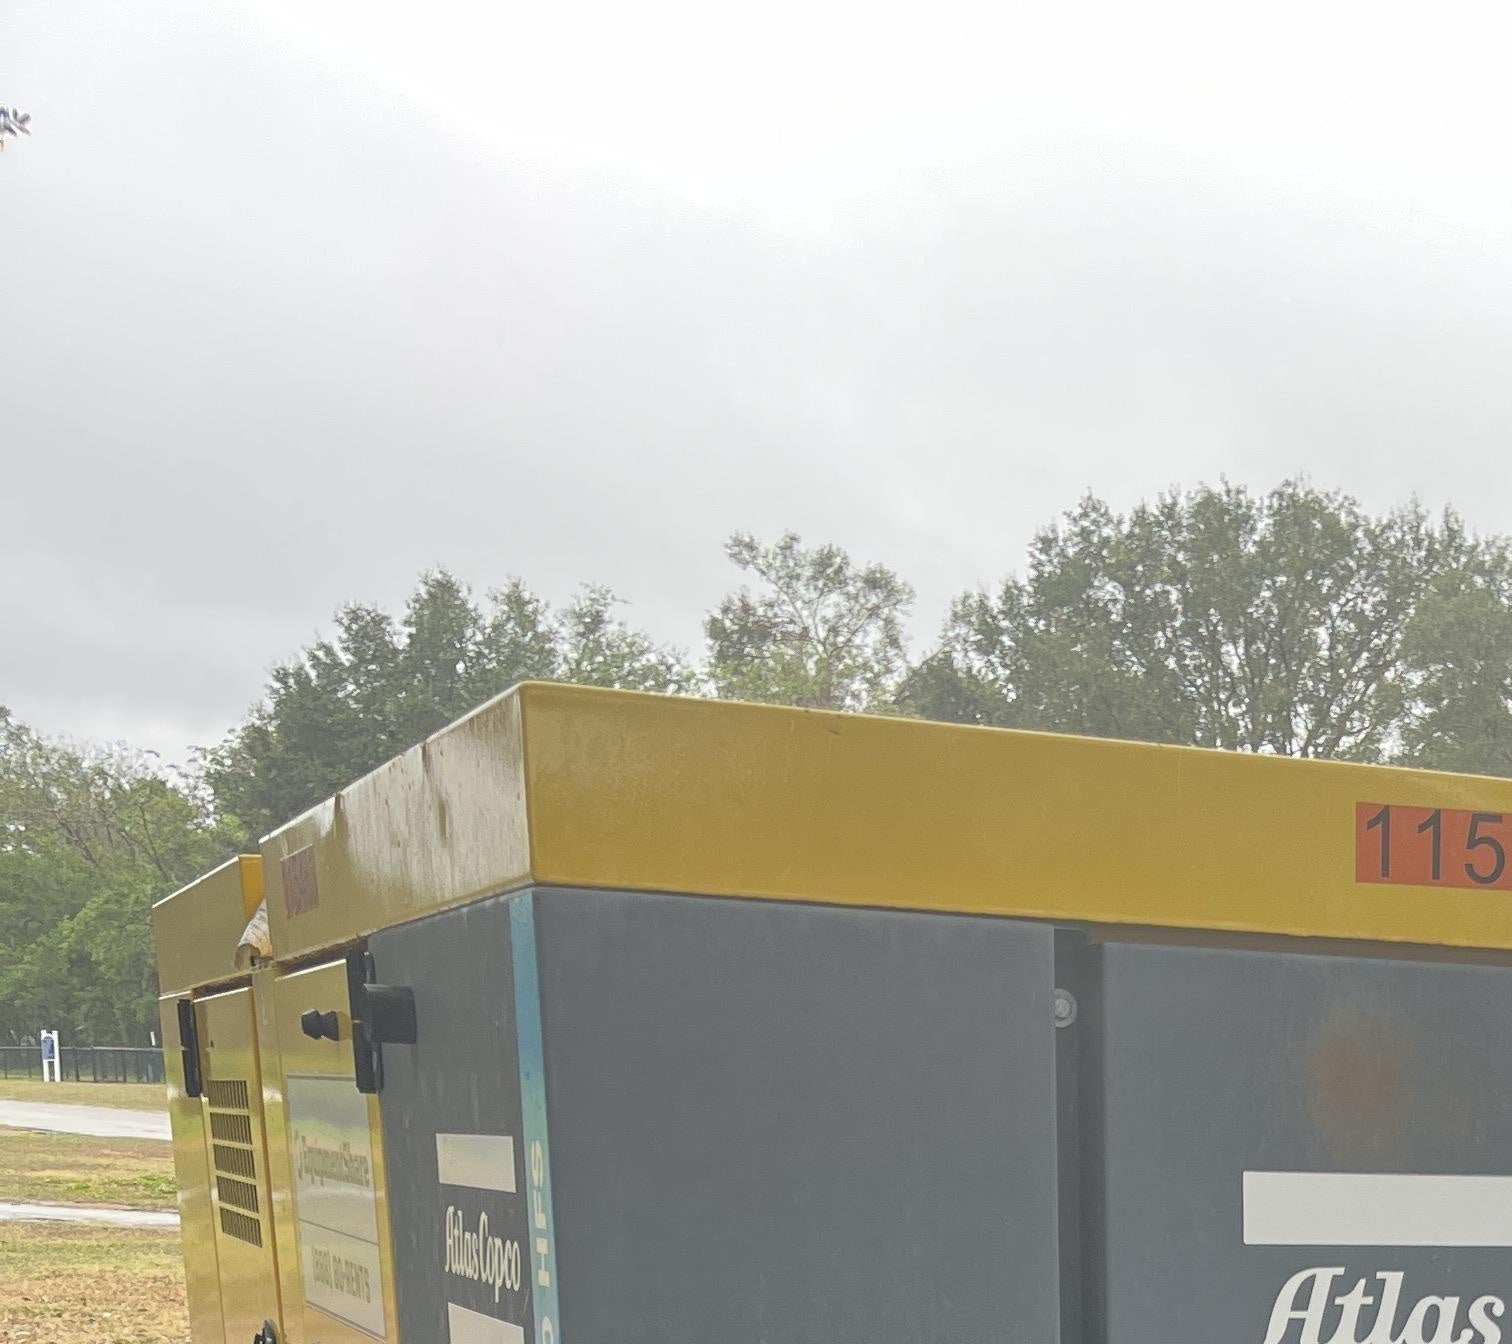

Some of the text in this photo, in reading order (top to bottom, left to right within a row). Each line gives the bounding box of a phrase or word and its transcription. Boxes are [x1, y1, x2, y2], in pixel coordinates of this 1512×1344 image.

[445, 1205, 520, 1303] Atlas Copco
[531, 1140, 550, 1288] HFS
